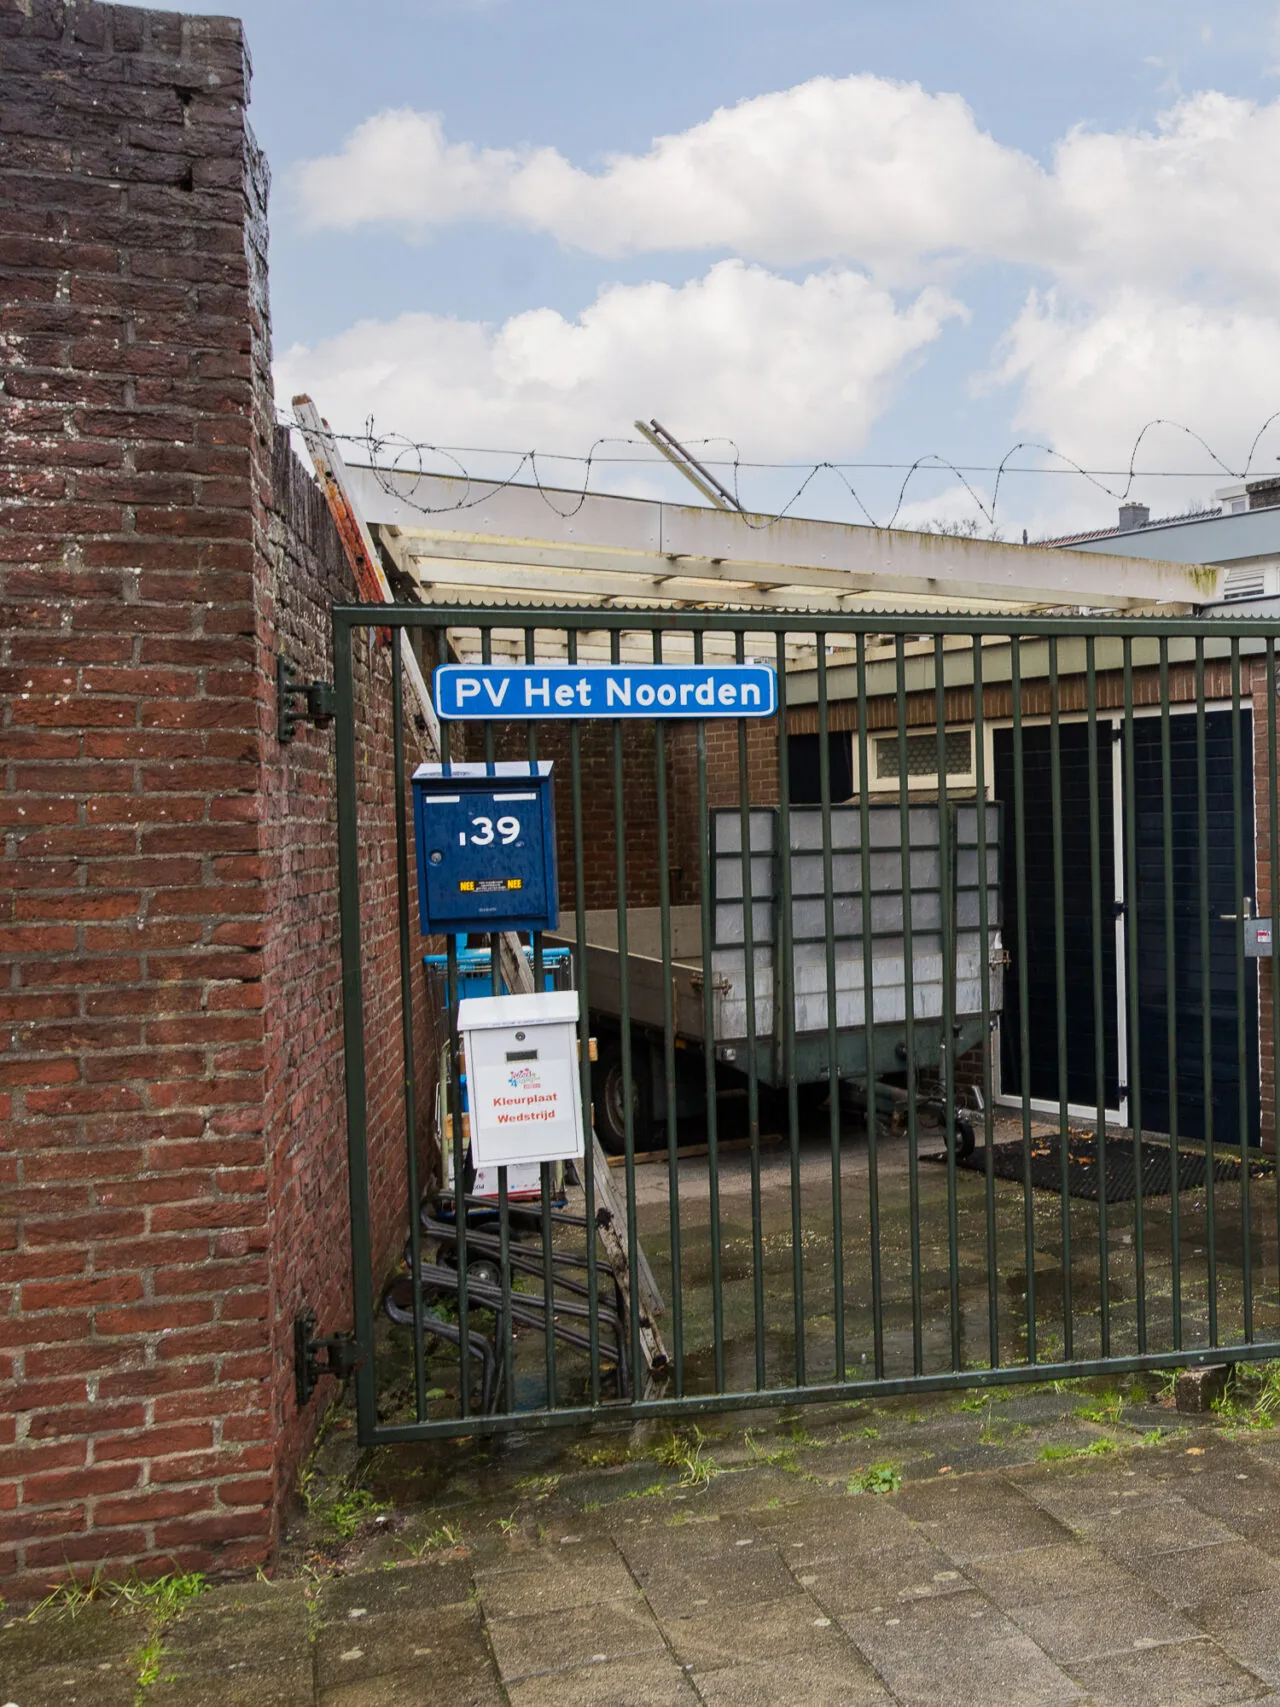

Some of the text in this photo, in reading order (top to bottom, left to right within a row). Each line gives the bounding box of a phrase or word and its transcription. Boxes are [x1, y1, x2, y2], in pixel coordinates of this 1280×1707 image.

[455, 676, 761, 708] PV Het Noorden
[460, 881, 475, 892] NEE
[507, 879, 522, 889] NEE
[493, 1092, 558, 1106] Kleurplaat
[497, 1109, 555, 1124] Wedstrijd
